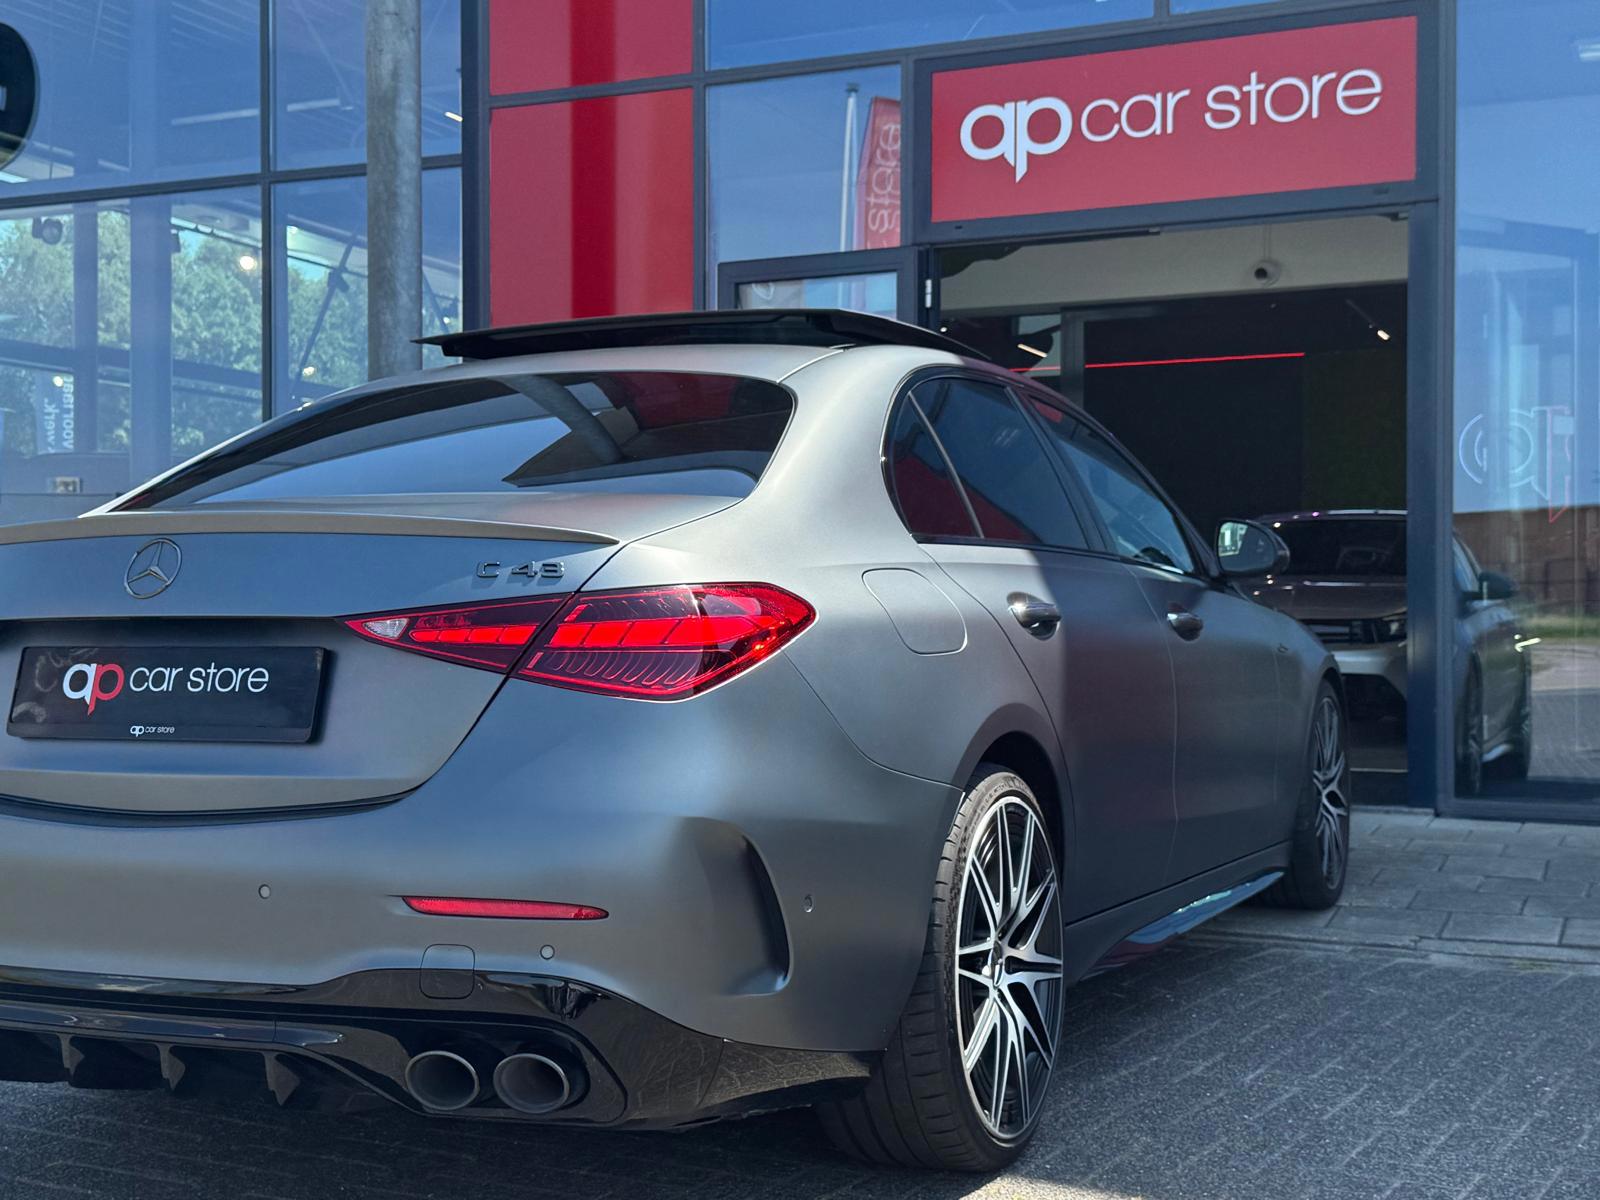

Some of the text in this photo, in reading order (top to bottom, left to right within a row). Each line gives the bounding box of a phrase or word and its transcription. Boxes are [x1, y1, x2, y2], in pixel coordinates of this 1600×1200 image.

[960, 69, 1382, 183] ap car store
[477, 560, 565, 579] C 43
[62, 661, 270, 716] ap car store
[130, 725, 144, 737] ap
